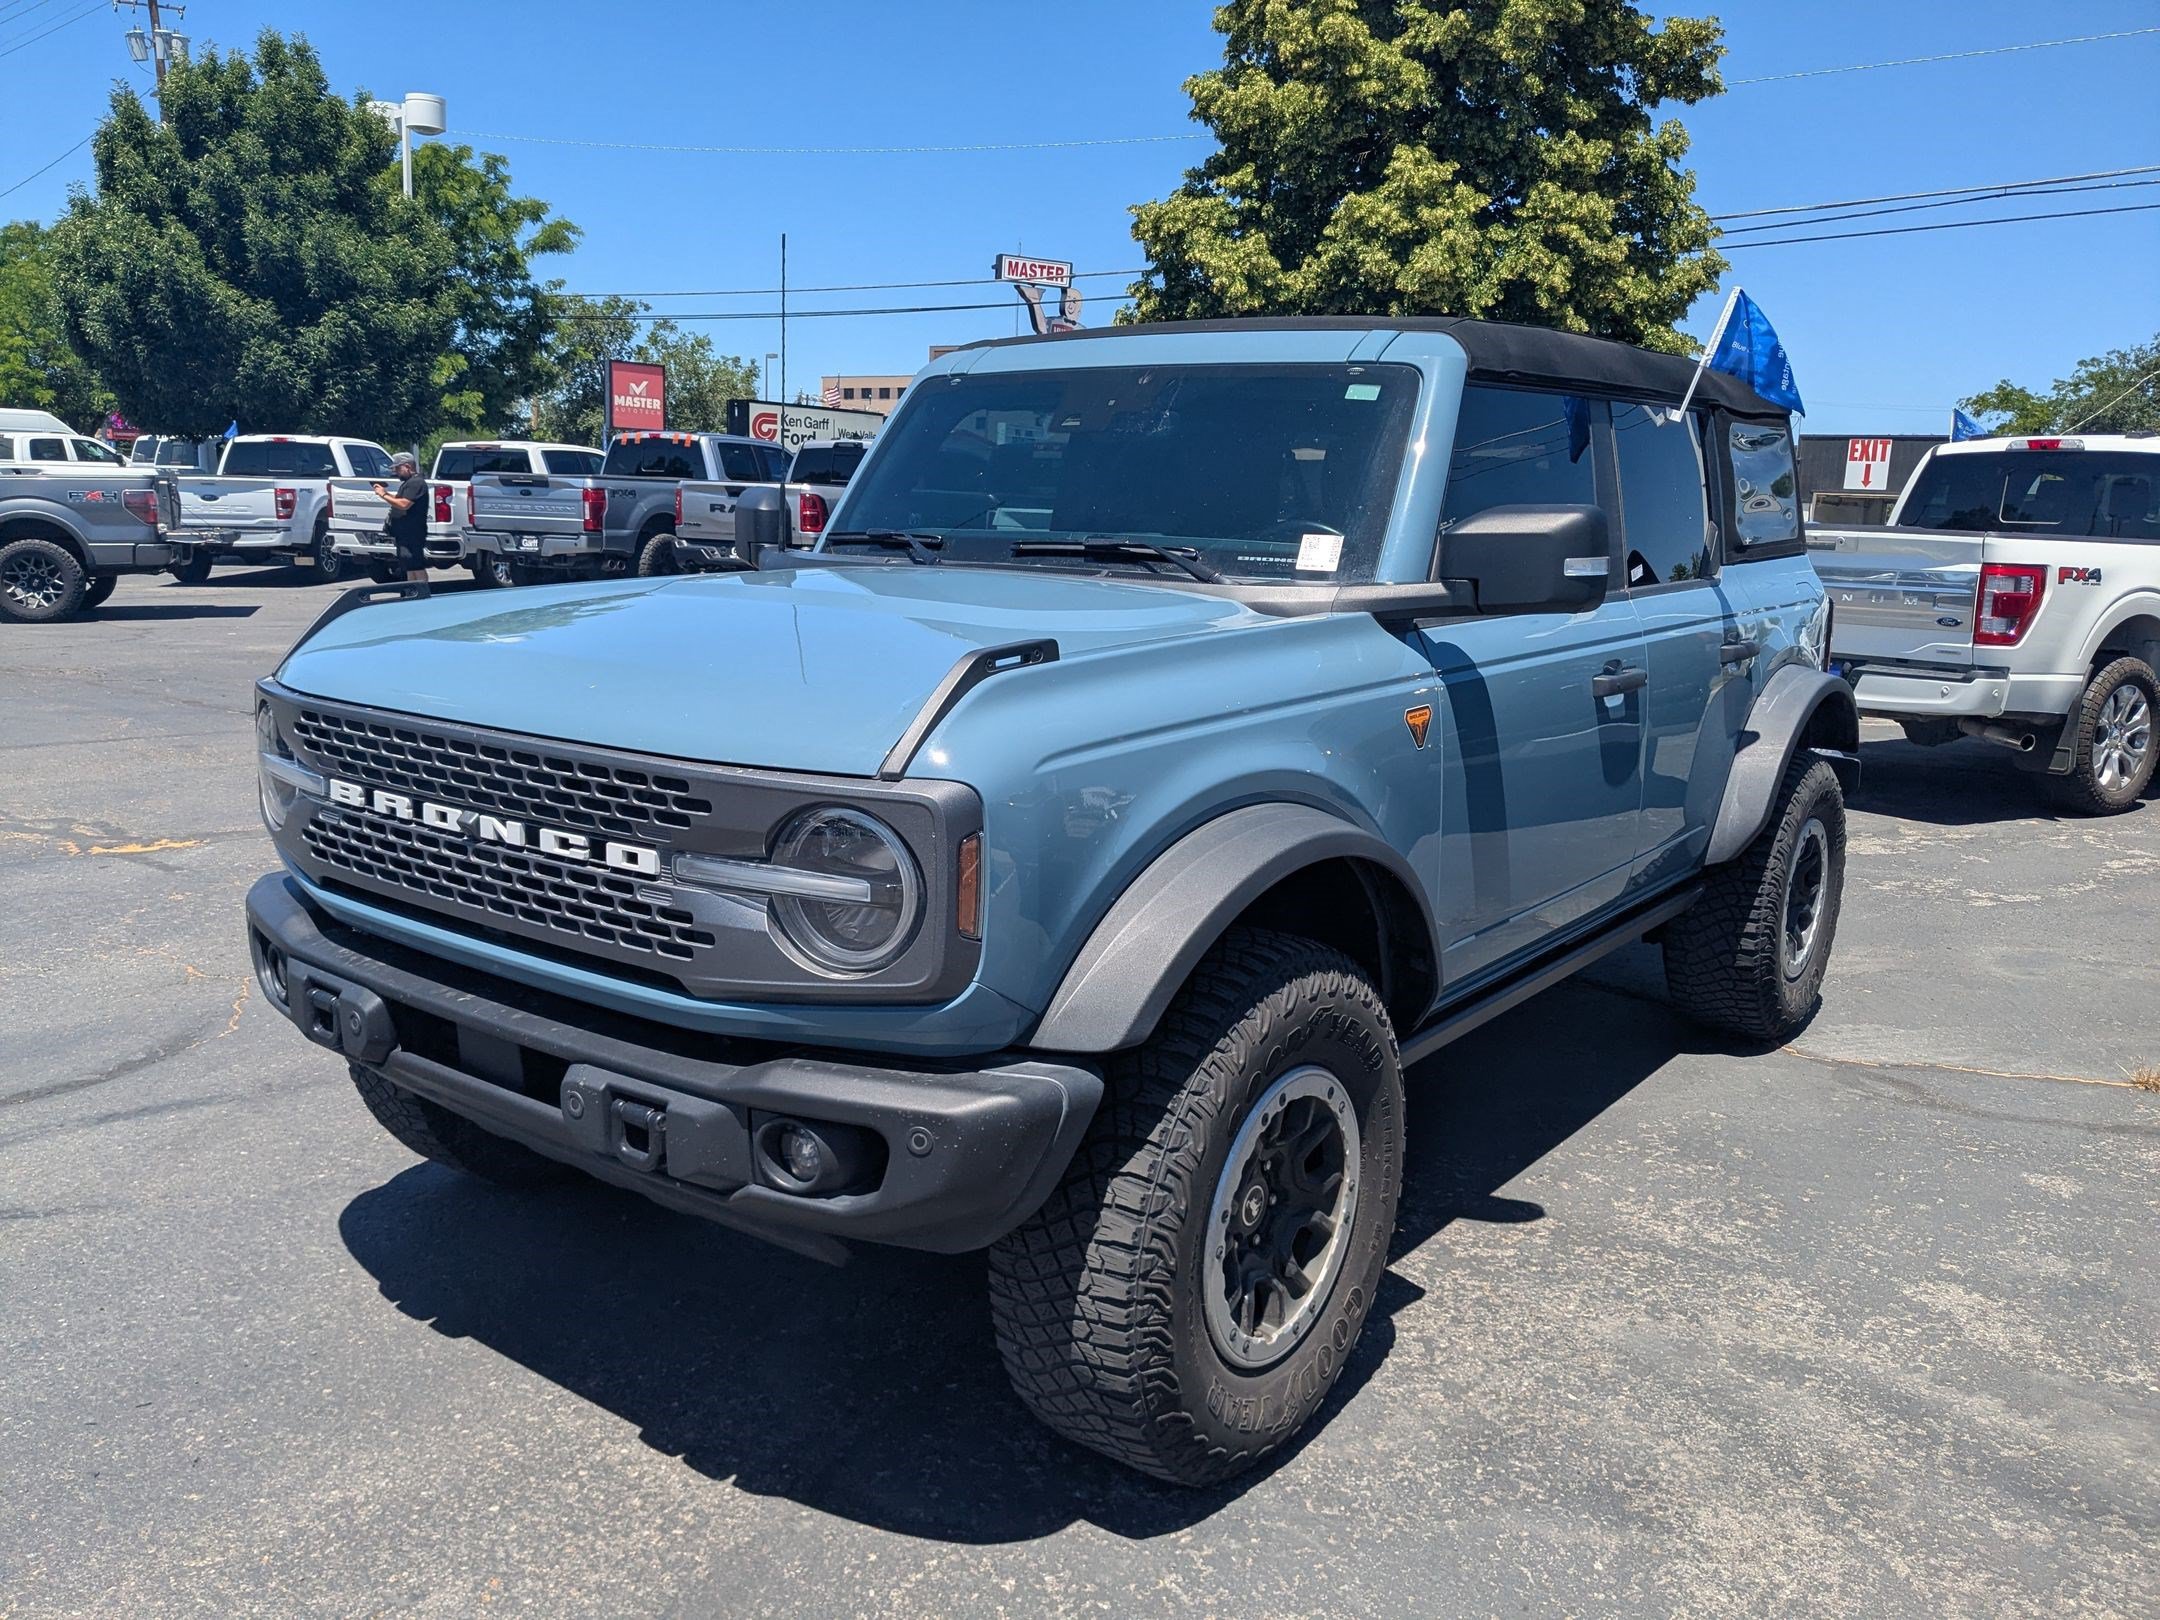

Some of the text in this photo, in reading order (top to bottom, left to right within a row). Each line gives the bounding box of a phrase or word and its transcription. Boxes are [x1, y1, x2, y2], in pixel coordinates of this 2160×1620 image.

[1007, 261, 1065, 282] MASTER
[614, 395, 661, 410] MASTER
[782, 413, 829, 431] Ken Garff
[1848, 439, 1890, 462] EXIT
[2058, 566, 2102, 584] FX4
[329, 778, 661, 876] BRONCO
